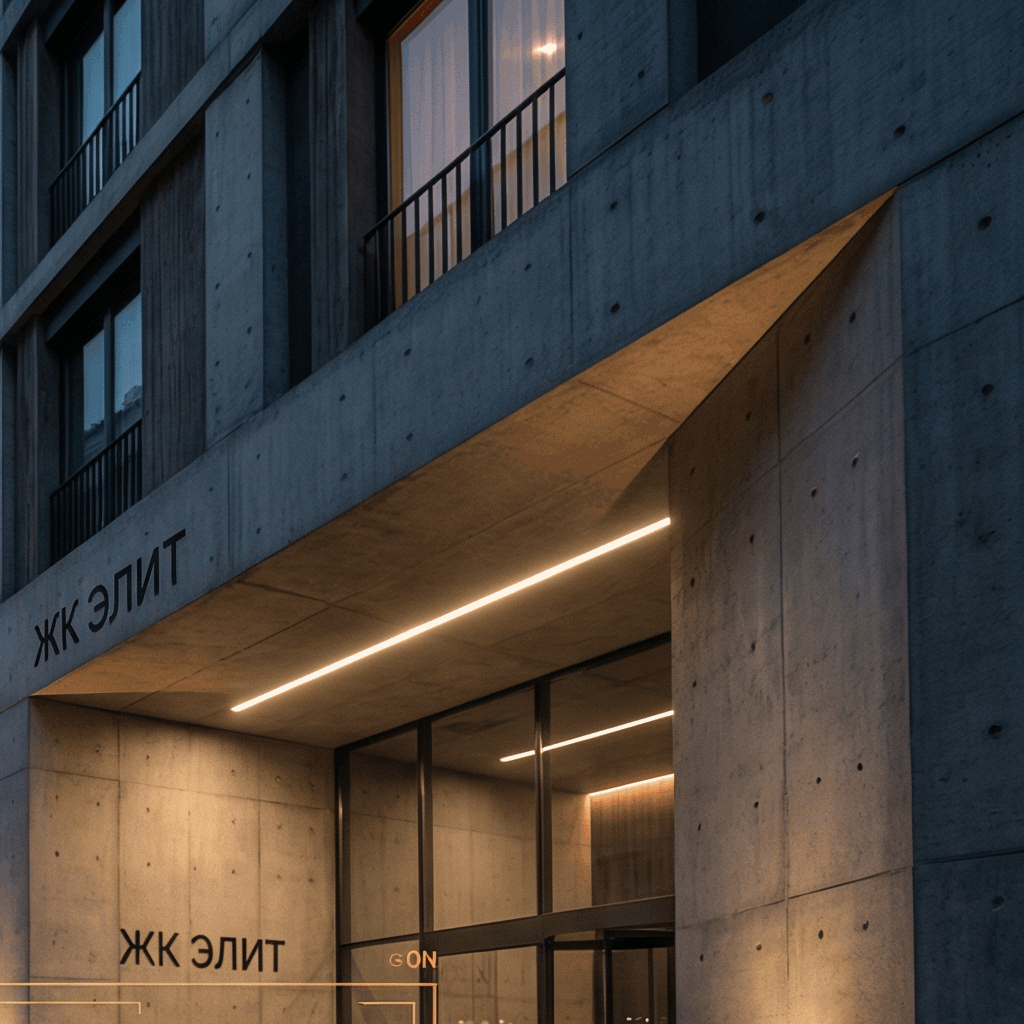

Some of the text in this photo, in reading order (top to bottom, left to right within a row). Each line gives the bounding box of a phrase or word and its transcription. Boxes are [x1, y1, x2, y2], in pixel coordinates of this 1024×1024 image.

[34, 529, 186, 668] ЖК ЭЛИТ
[119, 928, 286, 973] ЖК ЭЛИТ
